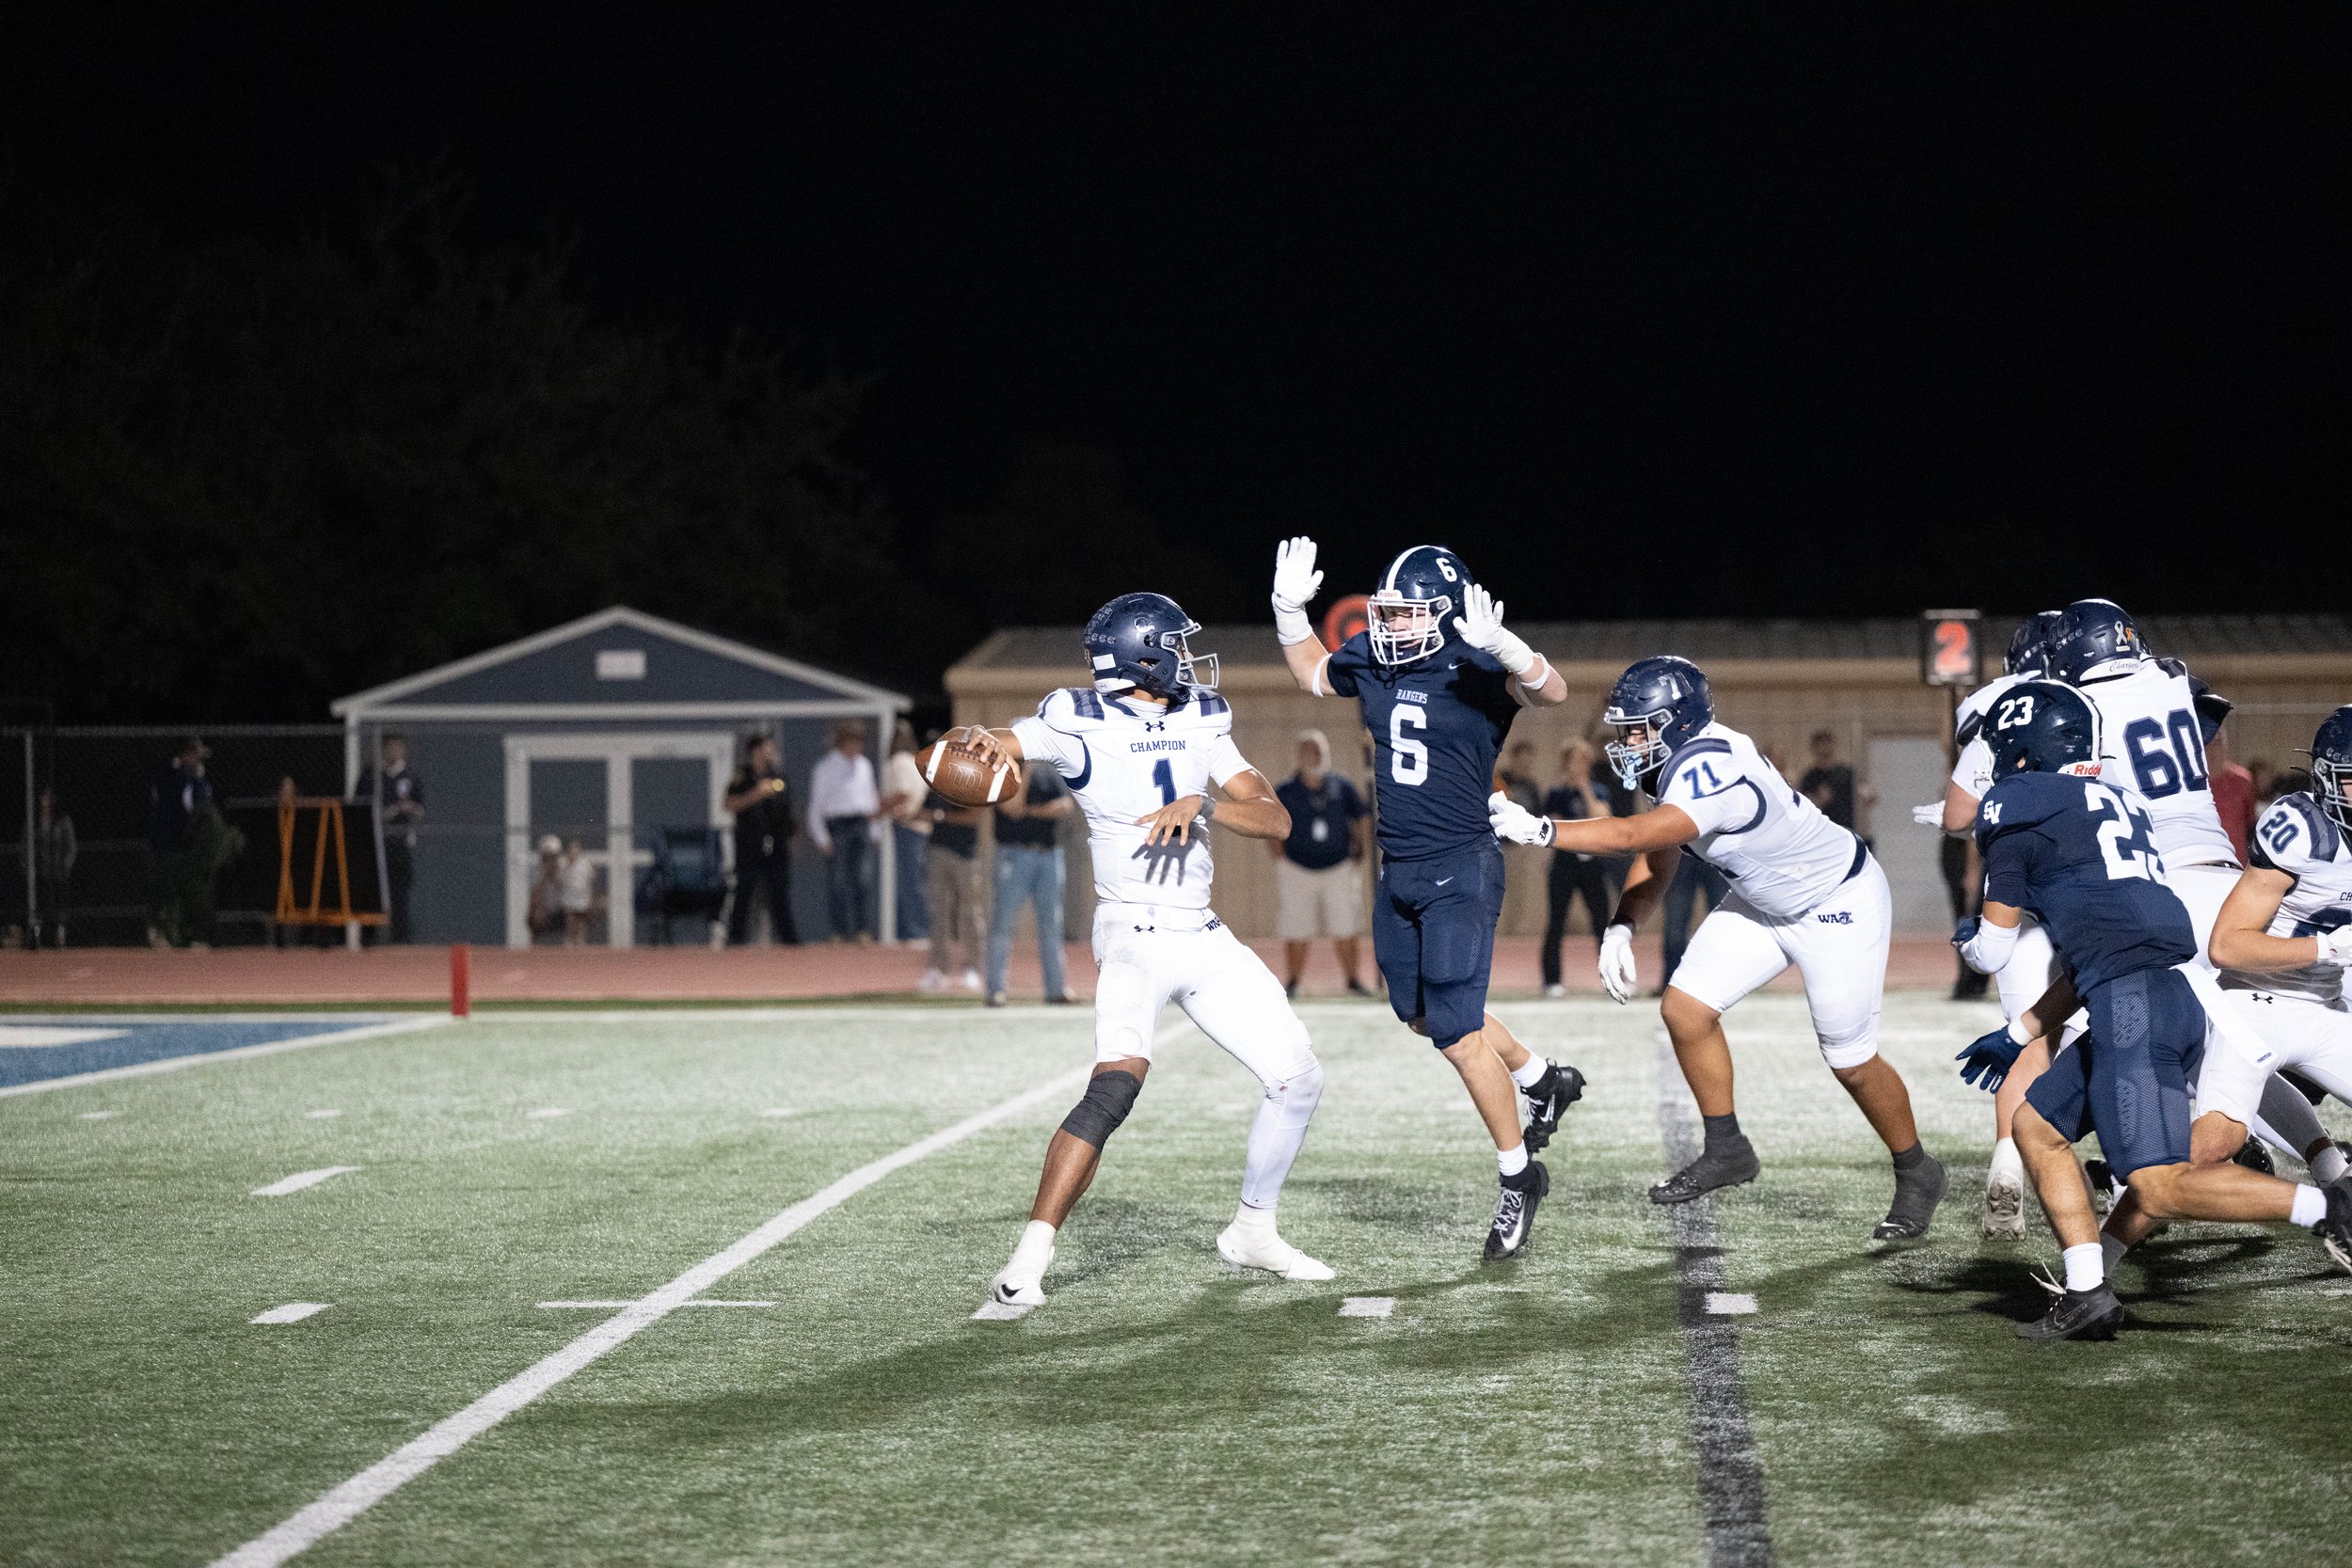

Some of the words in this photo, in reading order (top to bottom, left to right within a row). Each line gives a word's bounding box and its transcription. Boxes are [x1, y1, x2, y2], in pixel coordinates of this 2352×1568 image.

[1436, 558, 1457, 582] 6
[1934, 622, 1972, 675] 2
[1395, 689, 1428, 704] RANGERS
[1657, 671, 1693, 700] 71
[1998, 696, 2034, 731] 23
[1130, 740, 1186, 752] CHAMPION
[1390, 704, 1428, 786] 6
[2122, 707, 2208, 800] 60
[1681, 760, 1723, 800] 71
[2074, 765, 2102, 775] Ridd
[1983, 800, 2002, 825] SV
[2085, 782, 2166, 881] 23
[2260, 811, 2299, 854] 20
